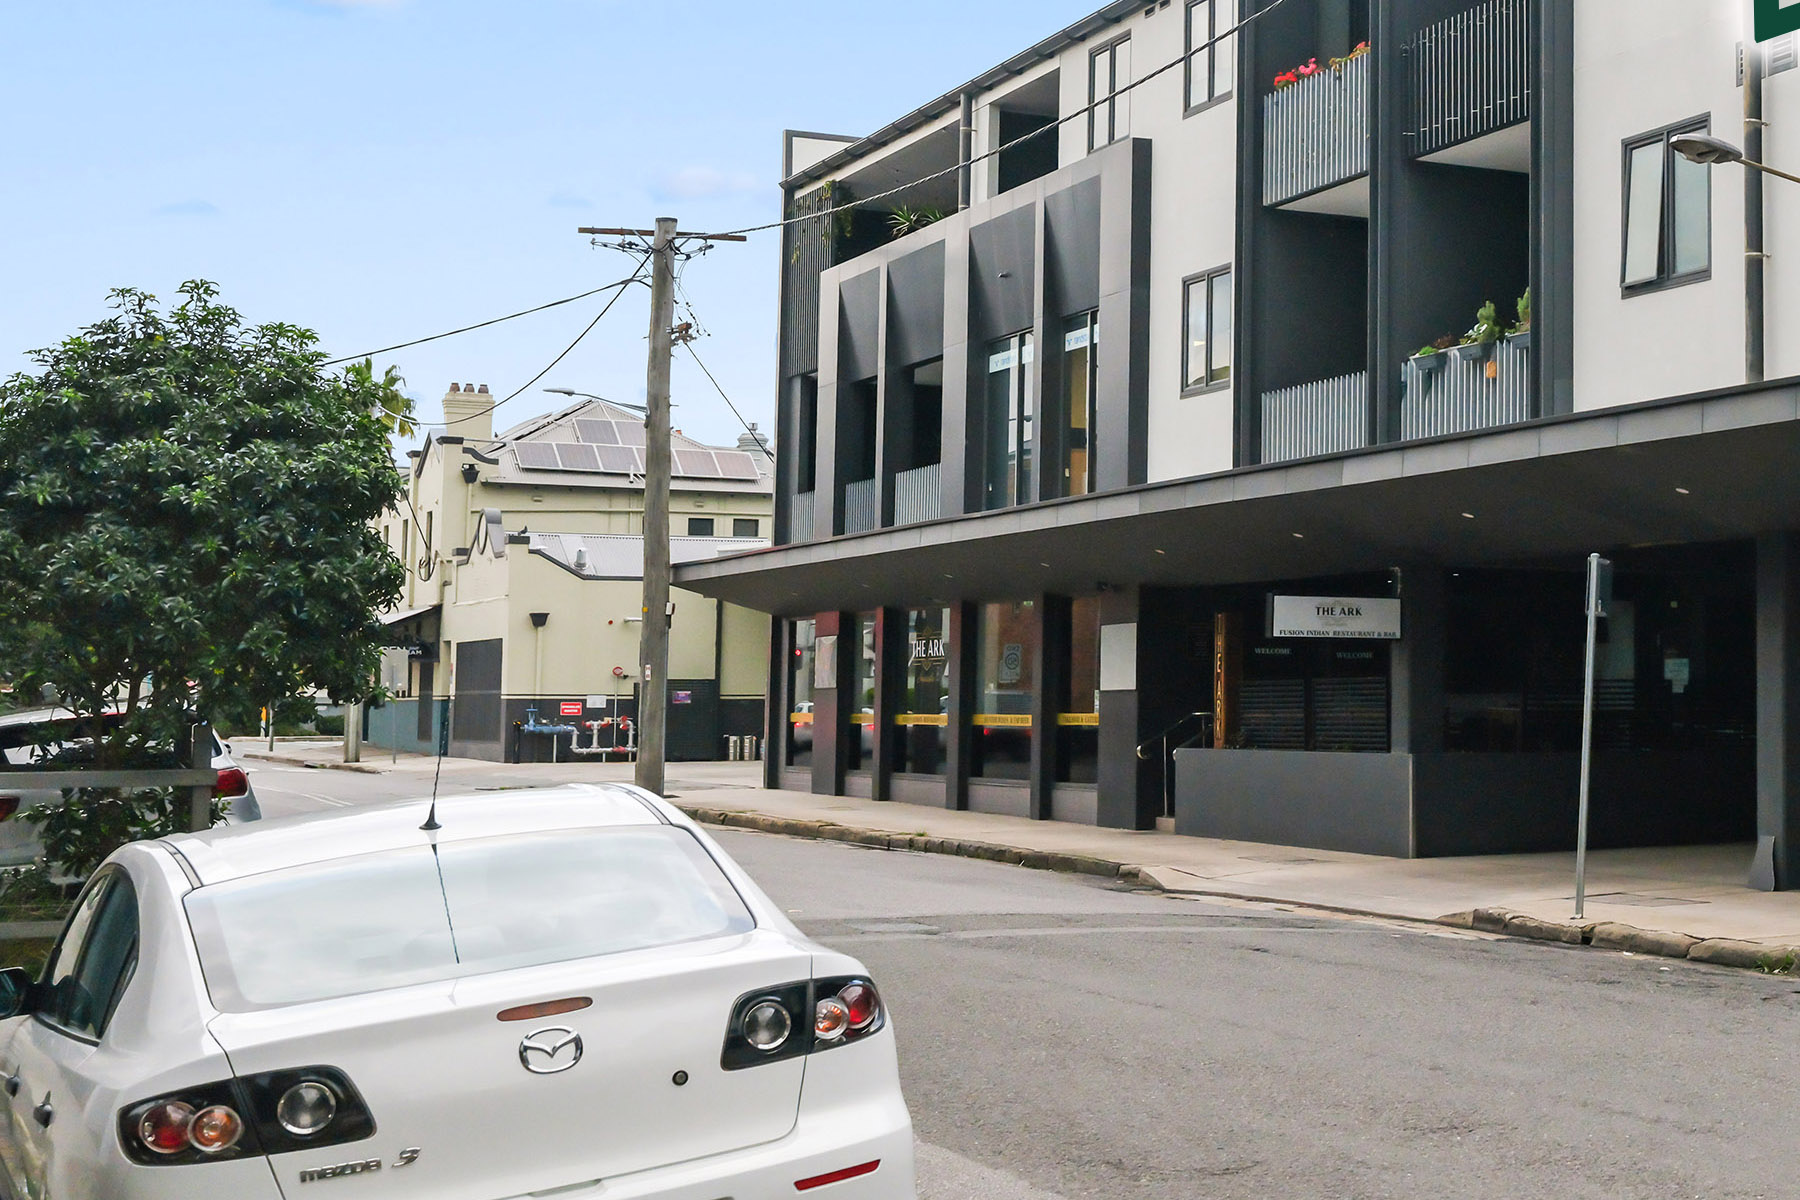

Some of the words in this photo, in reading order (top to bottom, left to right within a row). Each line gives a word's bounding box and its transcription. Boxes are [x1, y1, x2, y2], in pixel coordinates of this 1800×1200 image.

[1315, 606, 1336, 616] THE
[1339, 607, 1363, 617] ARK
[912, 640, 926, 658] THE
[928, 639, 945, 657] ARK
[1254, 647, 1292, 655] WELCOME
